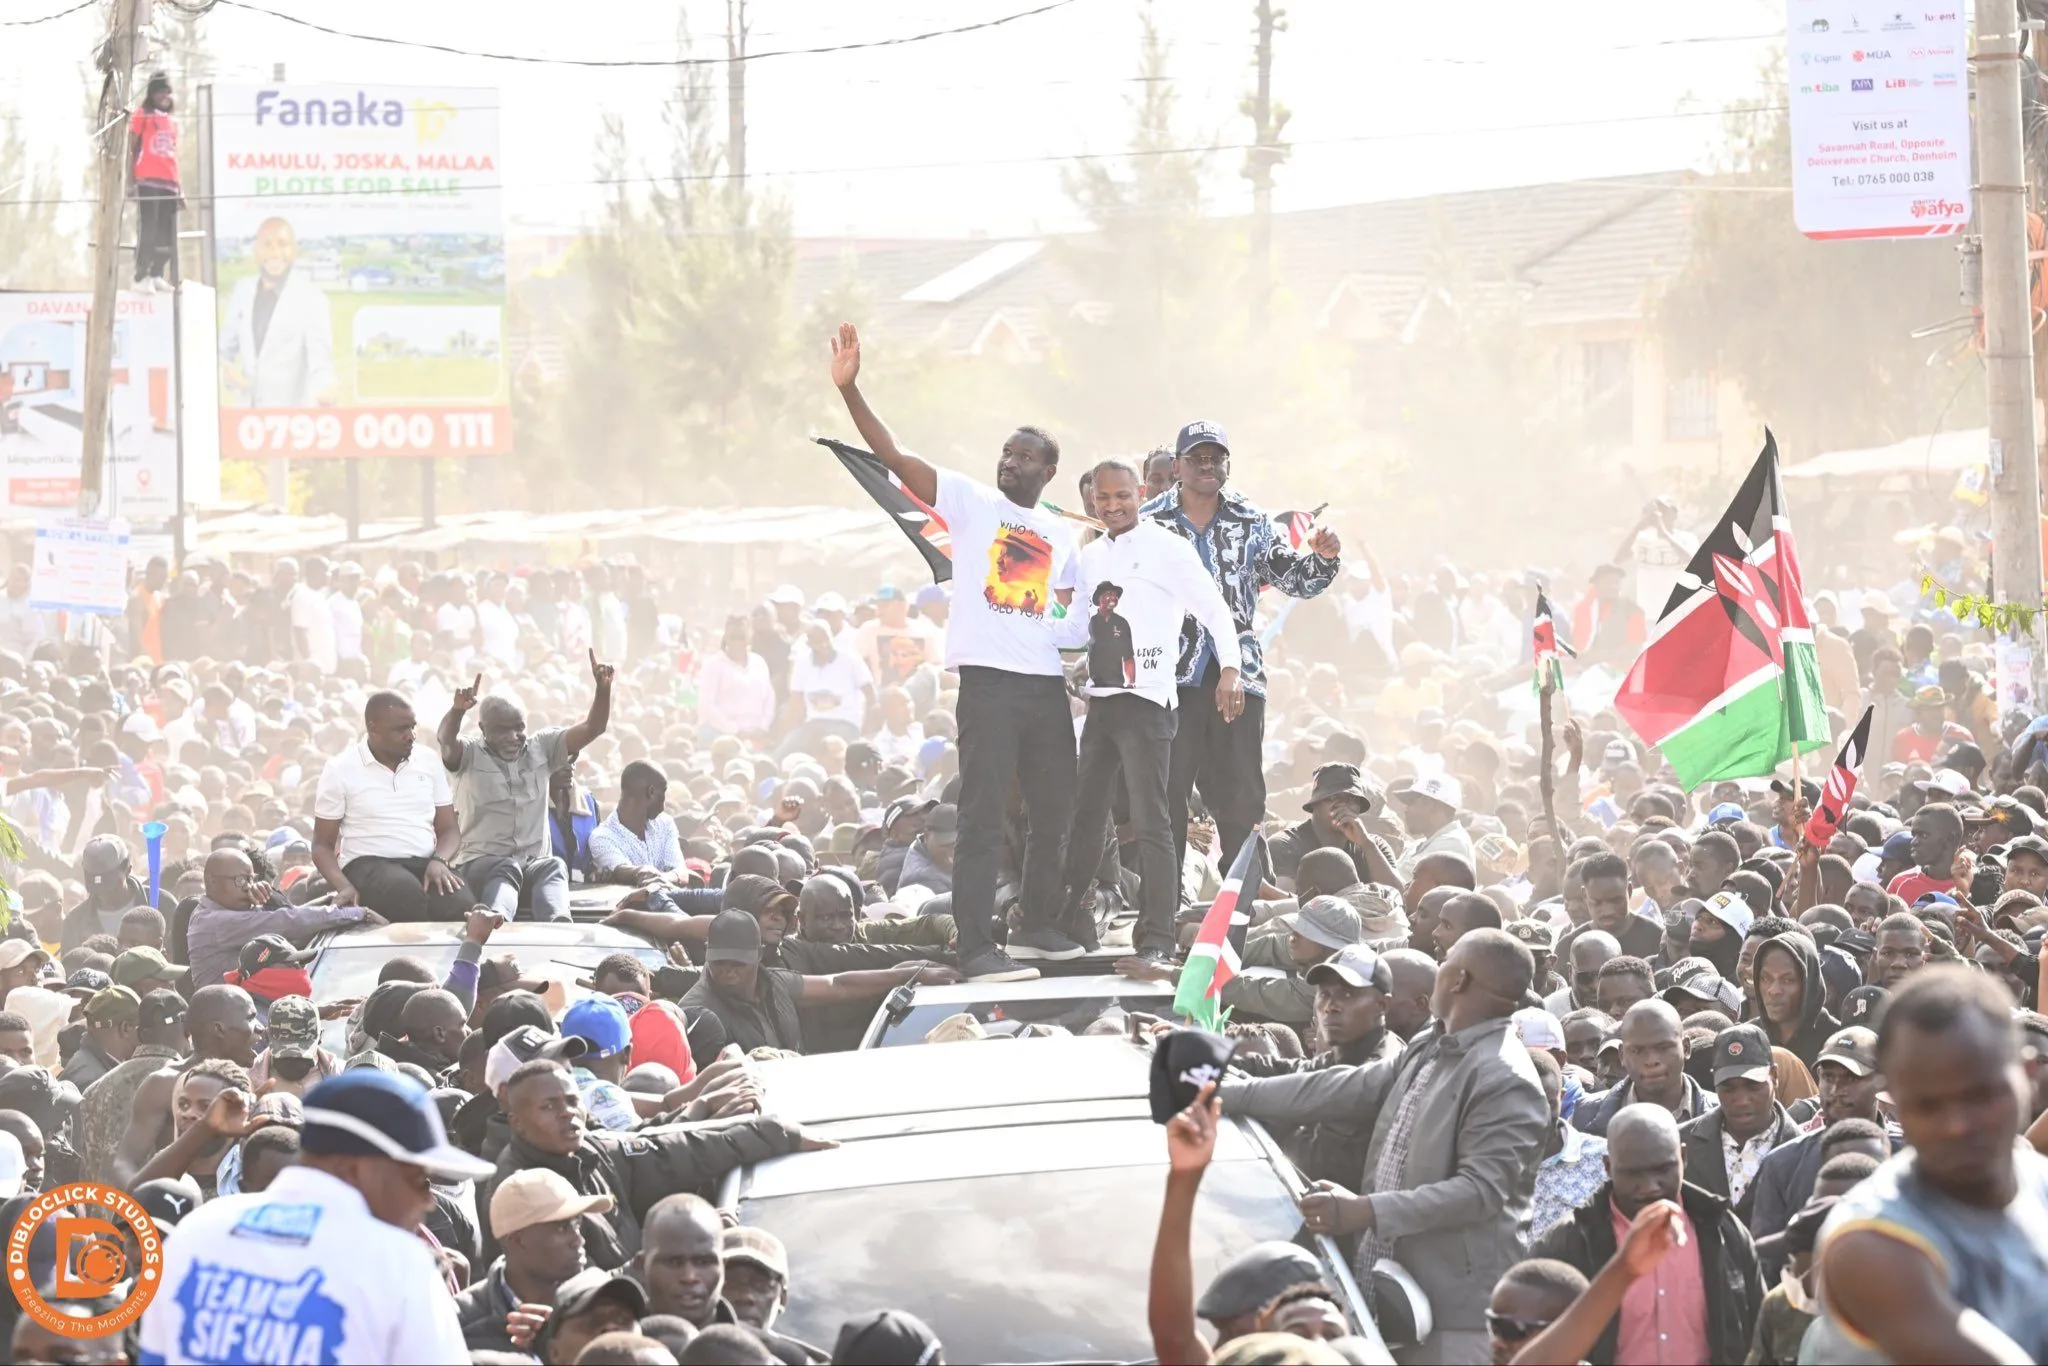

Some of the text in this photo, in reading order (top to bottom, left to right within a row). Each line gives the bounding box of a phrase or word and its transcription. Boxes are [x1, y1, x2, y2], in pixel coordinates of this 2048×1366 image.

[1867, 50, 1891, 62] MUA
[255, 90, 405, 127] Fanaka
[1852, 119, 1908, 131] Visit us at
[1818, 138, 1945, 154] Savannah Road, Opposite
[227, 151, 495, 172] KAMULU, JOSKA, MALAA
[1807, 150, 1957, 168] Deliverance Church, Donholm
[255, 177, 462, 197] PLOTS FOR SALE
[1832, 170, 1935, 187] Tel: 0765 000 038
[1927, 199, 1964, 218] afya
[237, 411, 495, 452] 0799 000 111
[999, 519, 1026, 535] WHO
[1137, 647, 1163, 658] LIVES
[1143, 659, 1158, 669] ON
[194, 1270, 279, 1315] TEAM
[189, 1309, 326, 1365] SIFUNA
